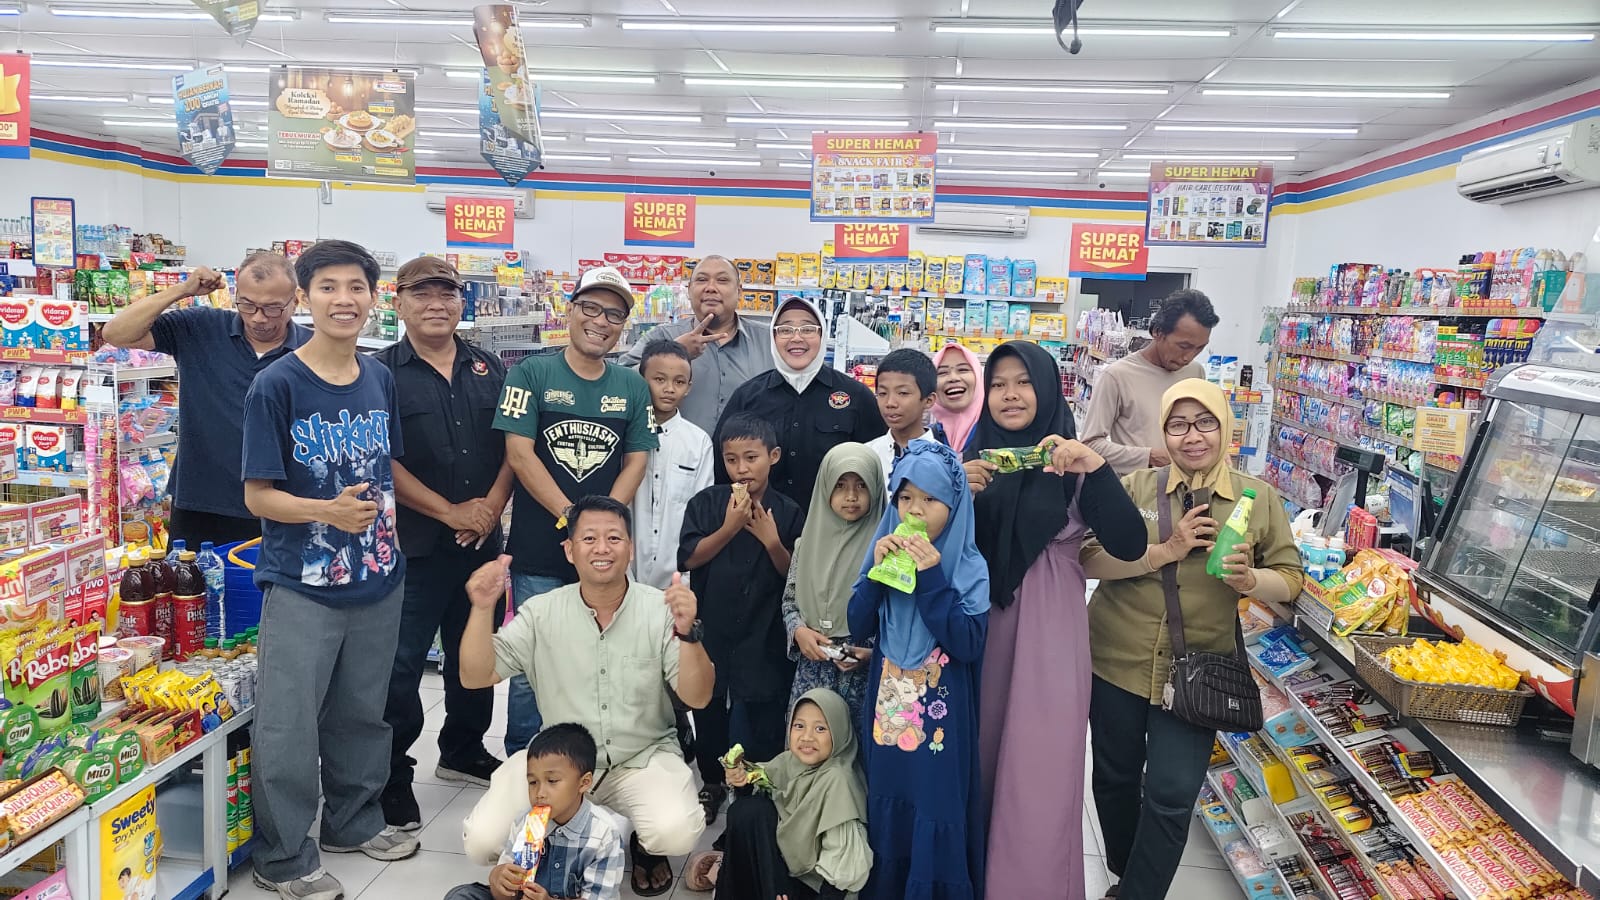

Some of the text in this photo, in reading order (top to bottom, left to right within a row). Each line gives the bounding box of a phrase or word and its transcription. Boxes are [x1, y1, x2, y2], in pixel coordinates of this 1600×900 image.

[288, 97, 320, 105] Ramadan
[827, 138, 922, 150] SUPER HEMAT
[838, 157, 904, 166] SNACK FAIR
[1164, 166, 1258, 178] SUPER HEMAT
[1177, 184, 1243, 192] HAIR CARE FESTIVAL
[454, 204, 506, 219] SUPER
[633, 202, 687, 216] SUPER
[454, 218, 506, 232] HEMAT
[633, 216, 687, 230] HEMAT
[843, 232, 899, 245] HEMAT
[1080, 231, 1140, 247] SUPER
[1079, 246, 1139, 261] HEMAT
[42, 307, 70, 315] vidoran
[547, 422, 617, 446] ENTHUSIASM
[35, 641, 59, 657] Kuaci
[72, 642, 97, 667] ebo
[26, 652, 70, 685] Rebo
[120, 749, 138, 761] MILO
[87, 768, 111, 780] MILO
[111, 796, 156, 835] Sweety
[112, 831, 127, 845] Dry
